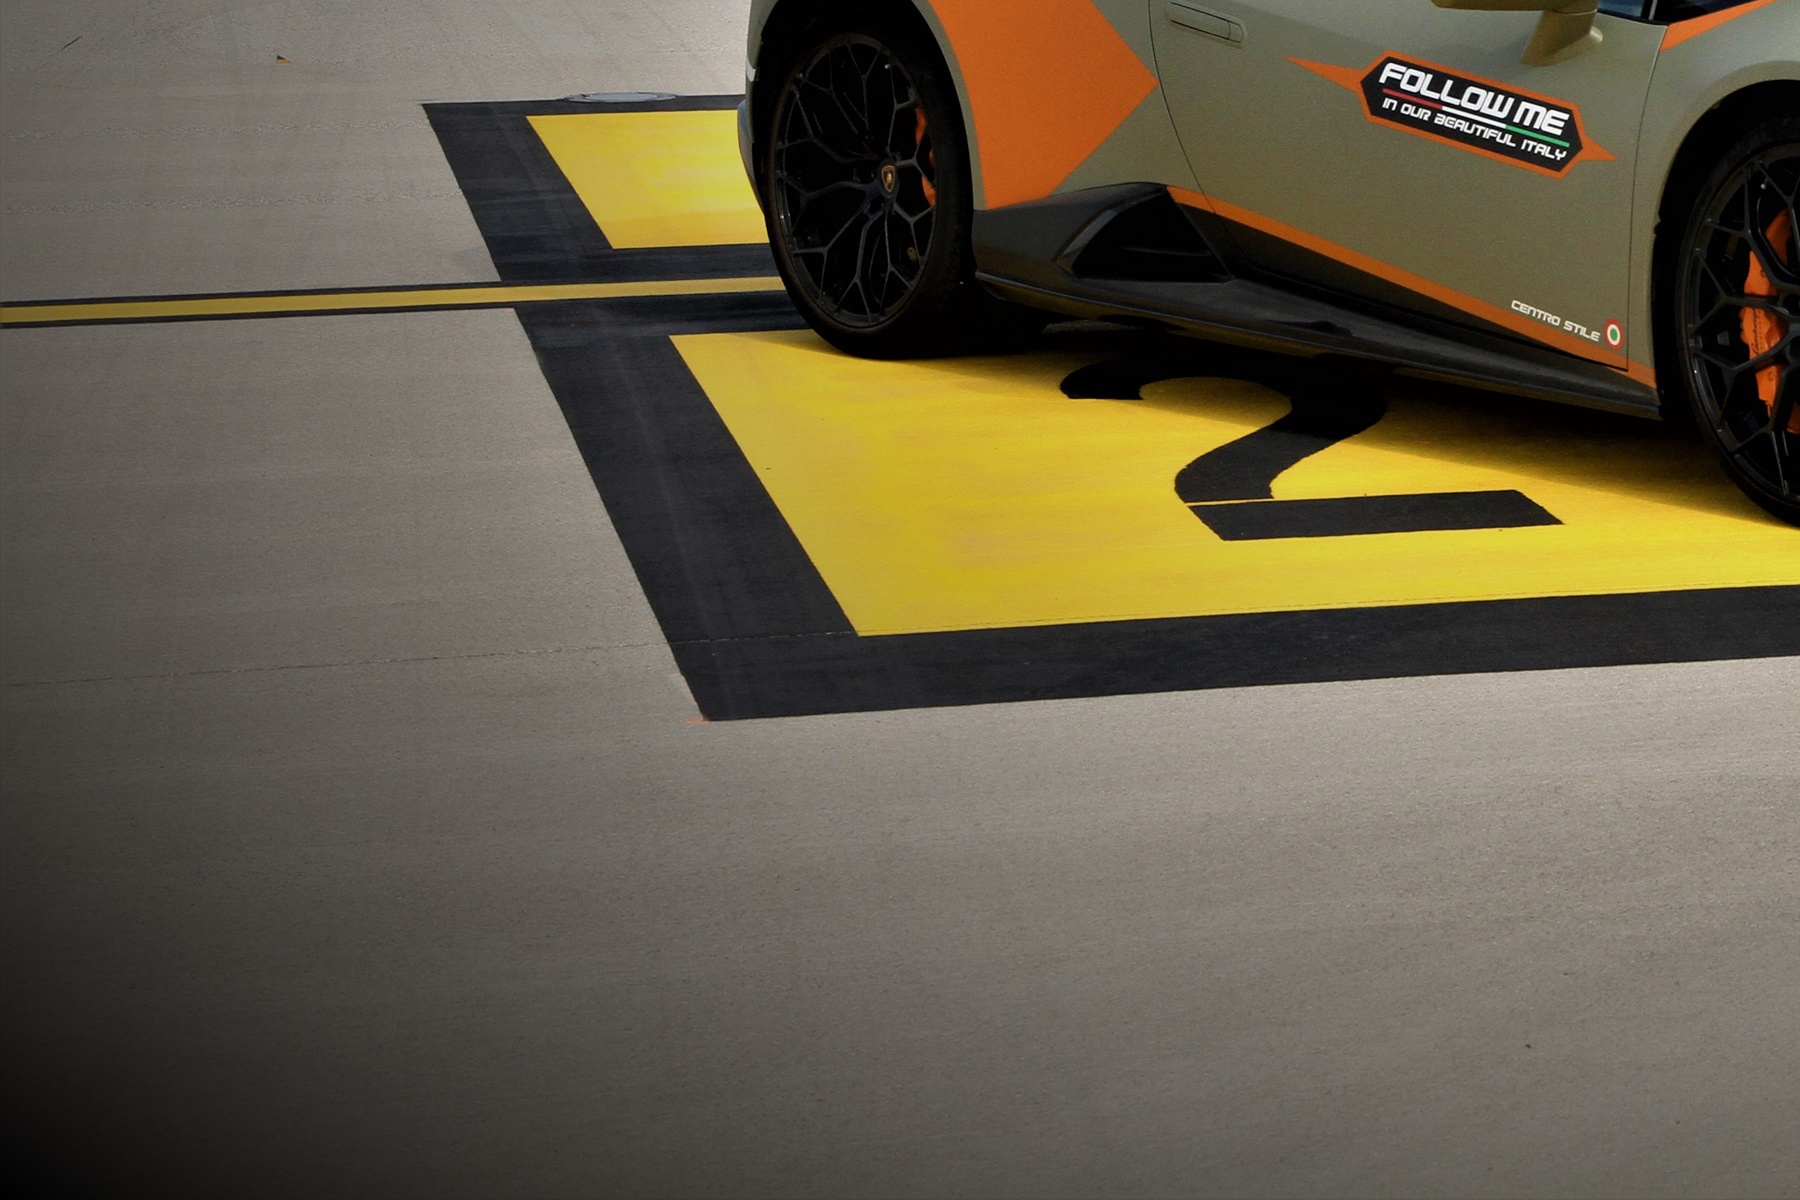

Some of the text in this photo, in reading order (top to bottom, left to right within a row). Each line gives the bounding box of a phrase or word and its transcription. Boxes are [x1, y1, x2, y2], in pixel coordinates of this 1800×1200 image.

[1378, 62, 1571, 137] FOLLOW ME
[1382, 97, 1568, 161] IN OUR BEAUTIFUL ITALY
[1510, 299, 1601, 342] CENTRO STILE
